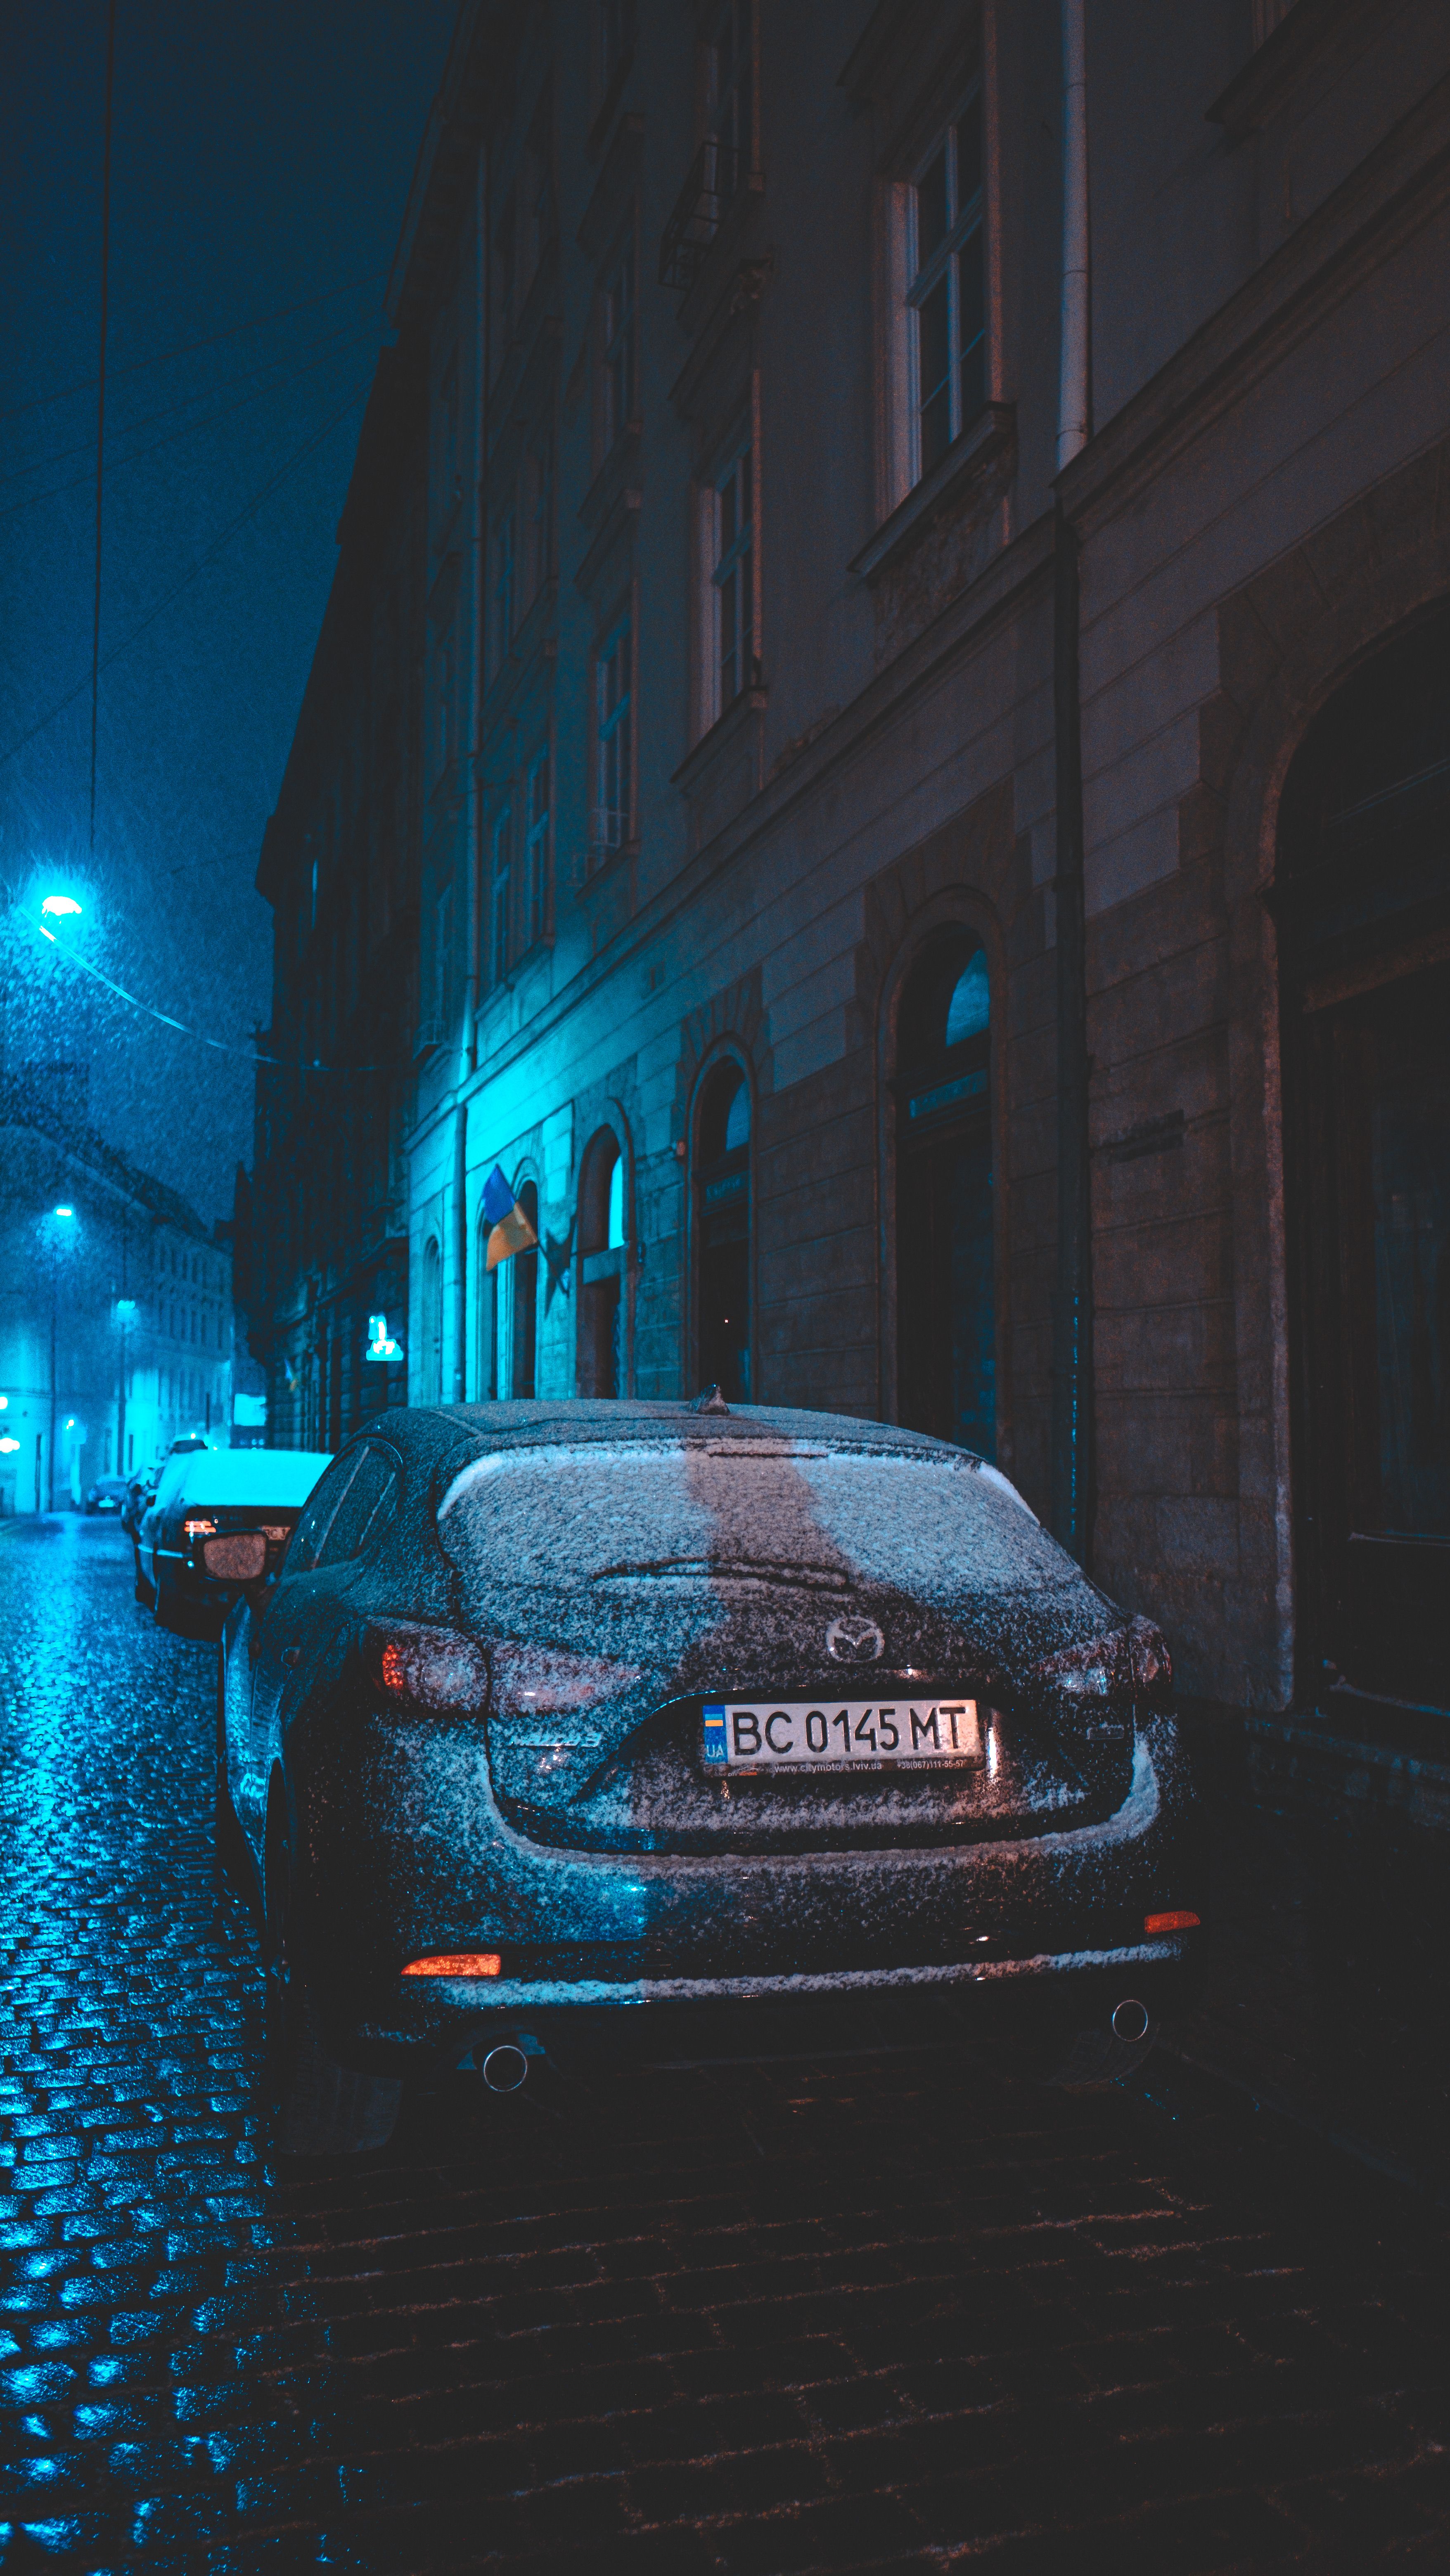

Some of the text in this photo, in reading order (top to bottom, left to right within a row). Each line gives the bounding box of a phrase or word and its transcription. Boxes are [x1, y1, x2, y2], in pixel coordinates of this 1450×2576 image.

[732, 1707, 966, 1755] BC 0145 MT
[706, 1743, 724, 1758] UA
